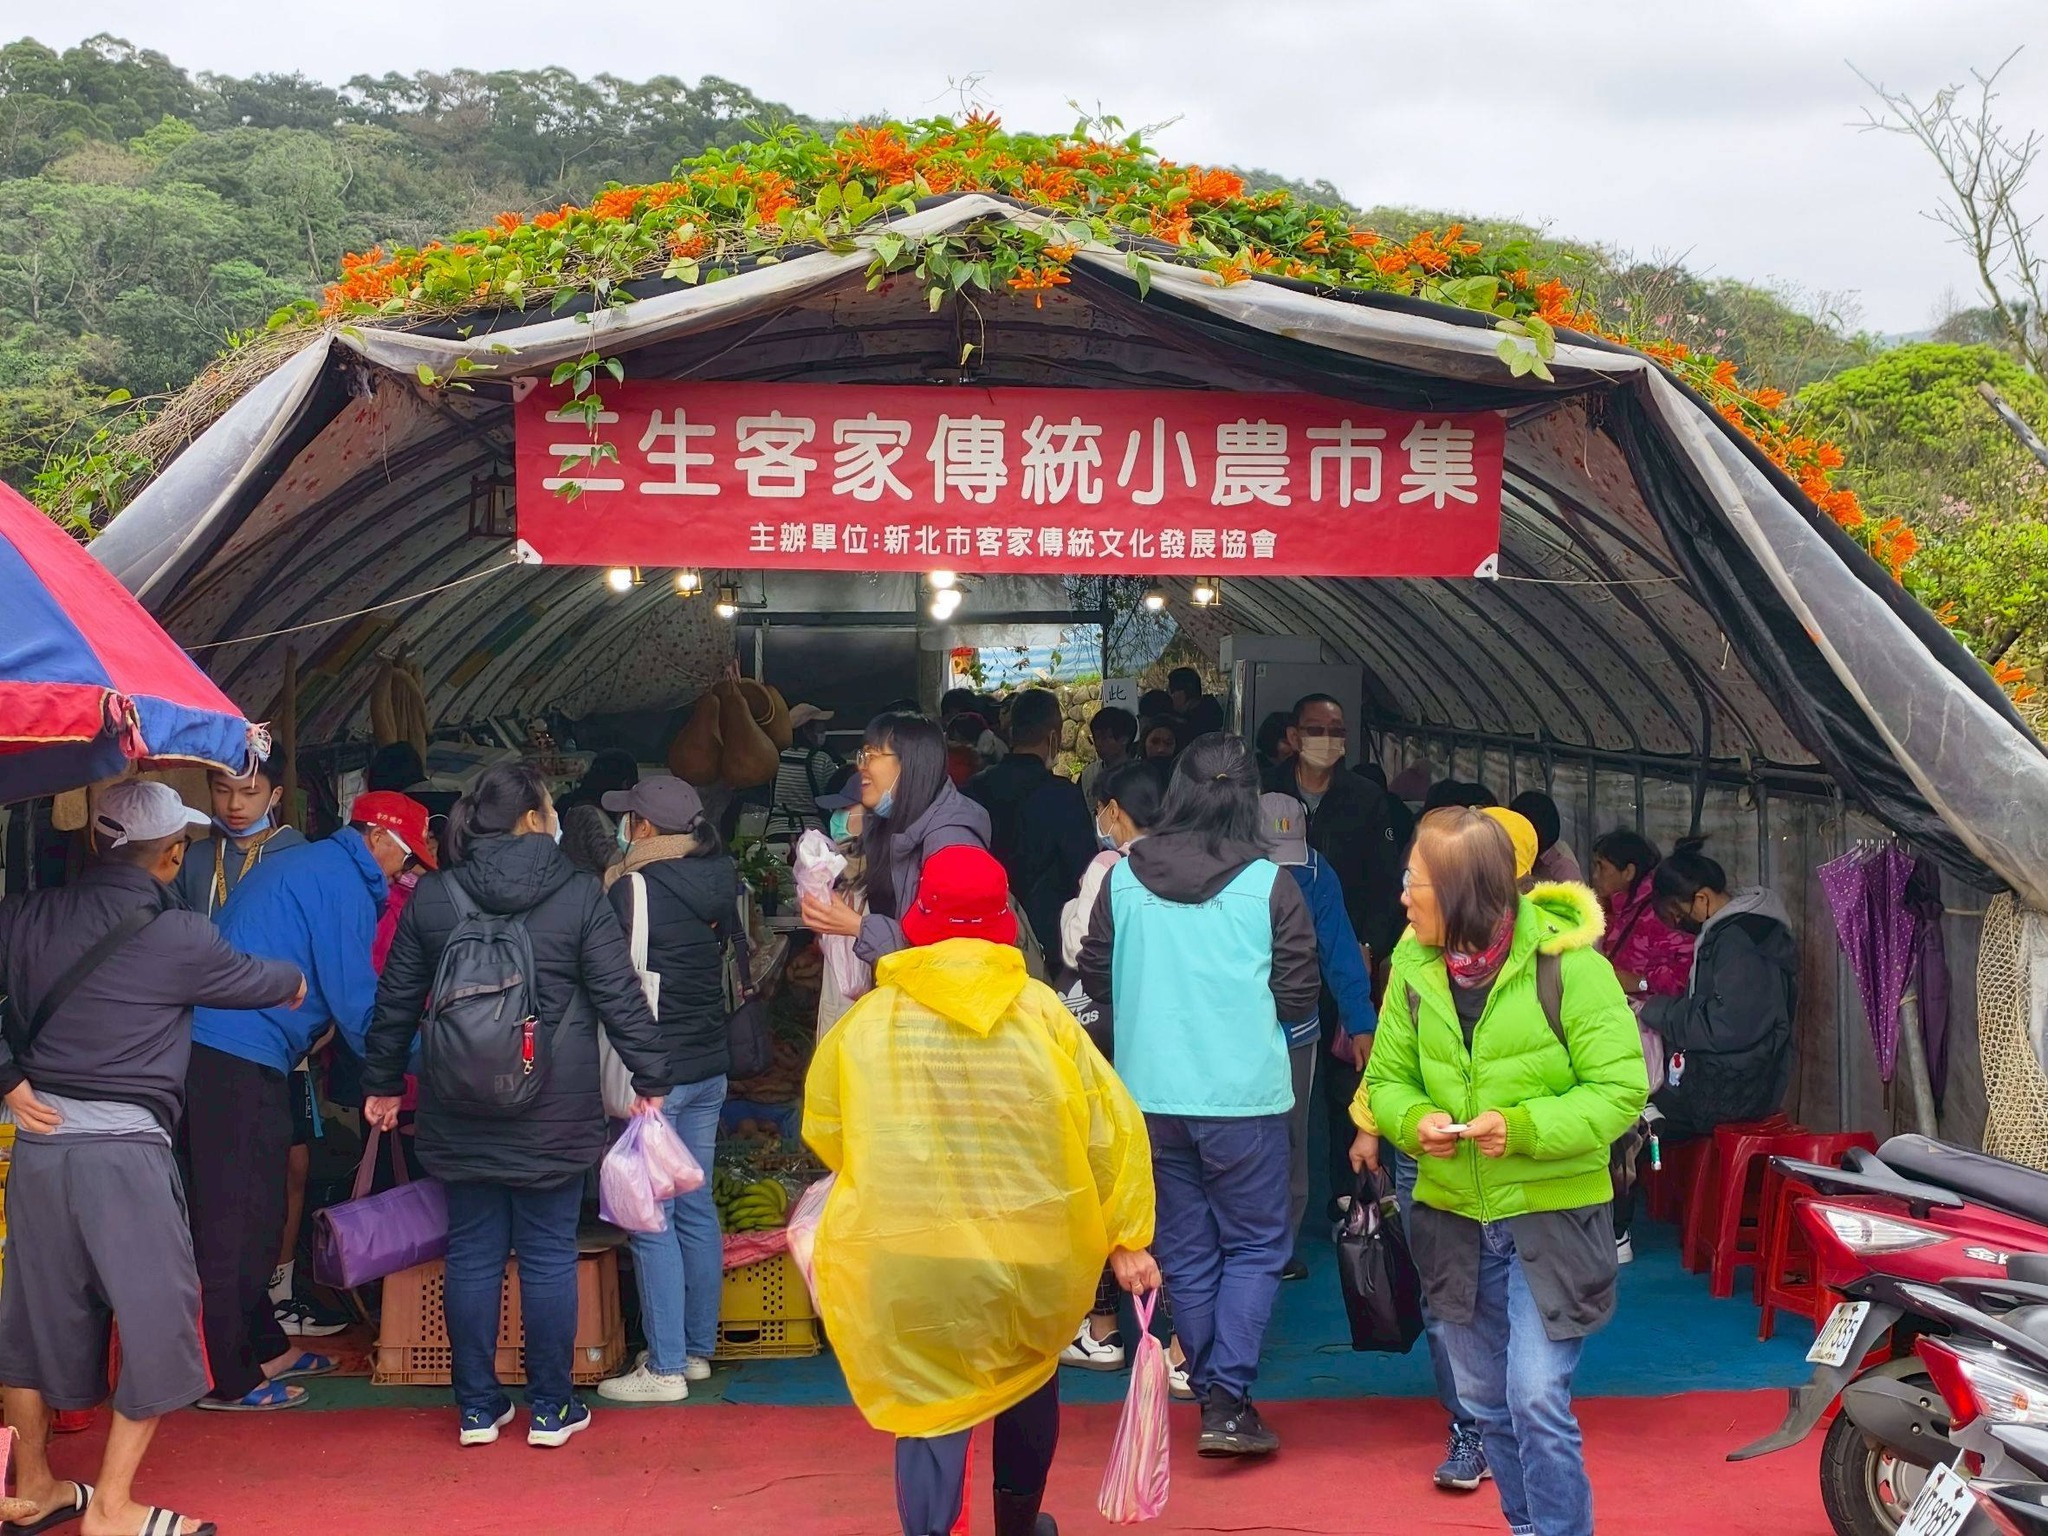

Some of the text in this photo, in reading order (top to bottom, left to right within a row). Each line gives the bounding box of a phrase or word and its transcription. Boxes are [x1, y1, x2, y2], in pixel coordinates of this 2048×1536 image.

[541, 407, 1479, 510] 三生客家傳統小農市集
[748, 521, 1279, 560] 主辦單位:新北市客家傳統文化發展協會
